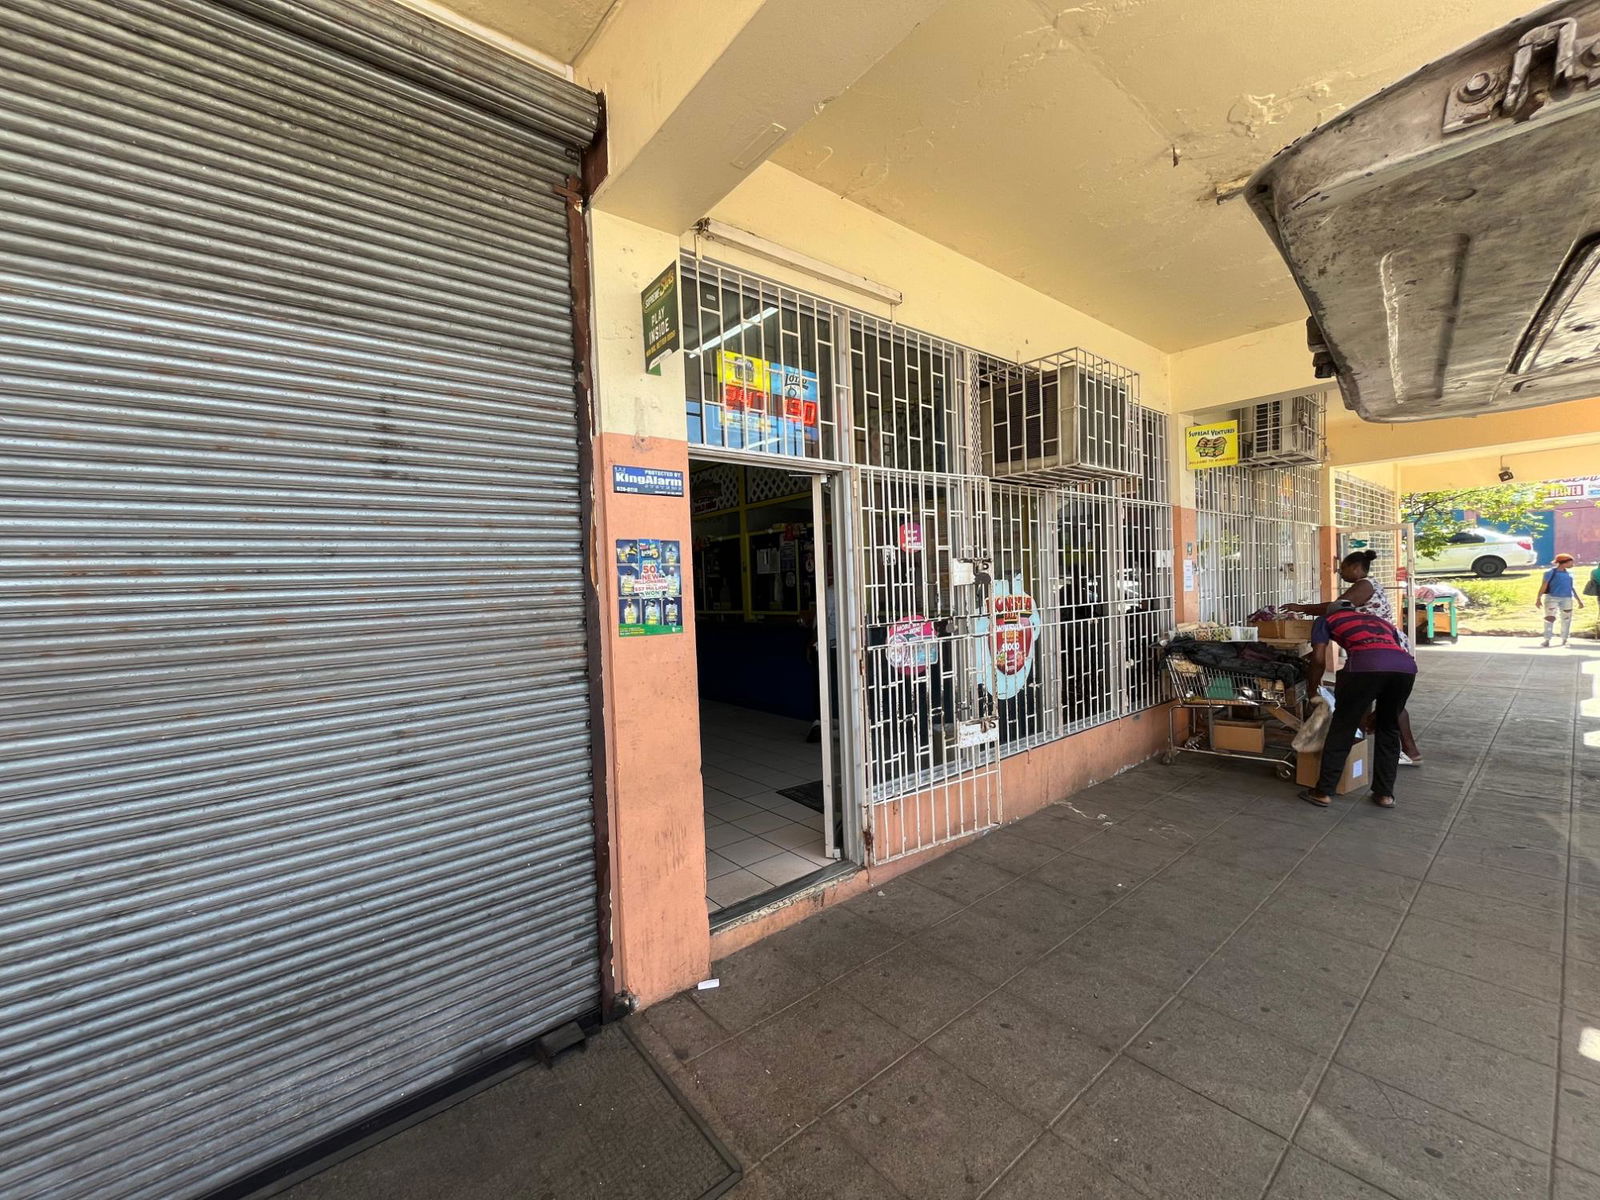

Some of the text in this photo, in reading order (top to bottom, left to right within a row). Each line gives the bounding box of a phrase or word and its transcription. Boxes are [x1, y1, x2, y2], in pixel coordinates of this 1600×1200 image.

[651, 306, 665, 327] PLAY
[649, 318, 669, 345] INSIDE
[615, 472, 682, 486] KingAlarm
[643, 565, 656, 573] 50
